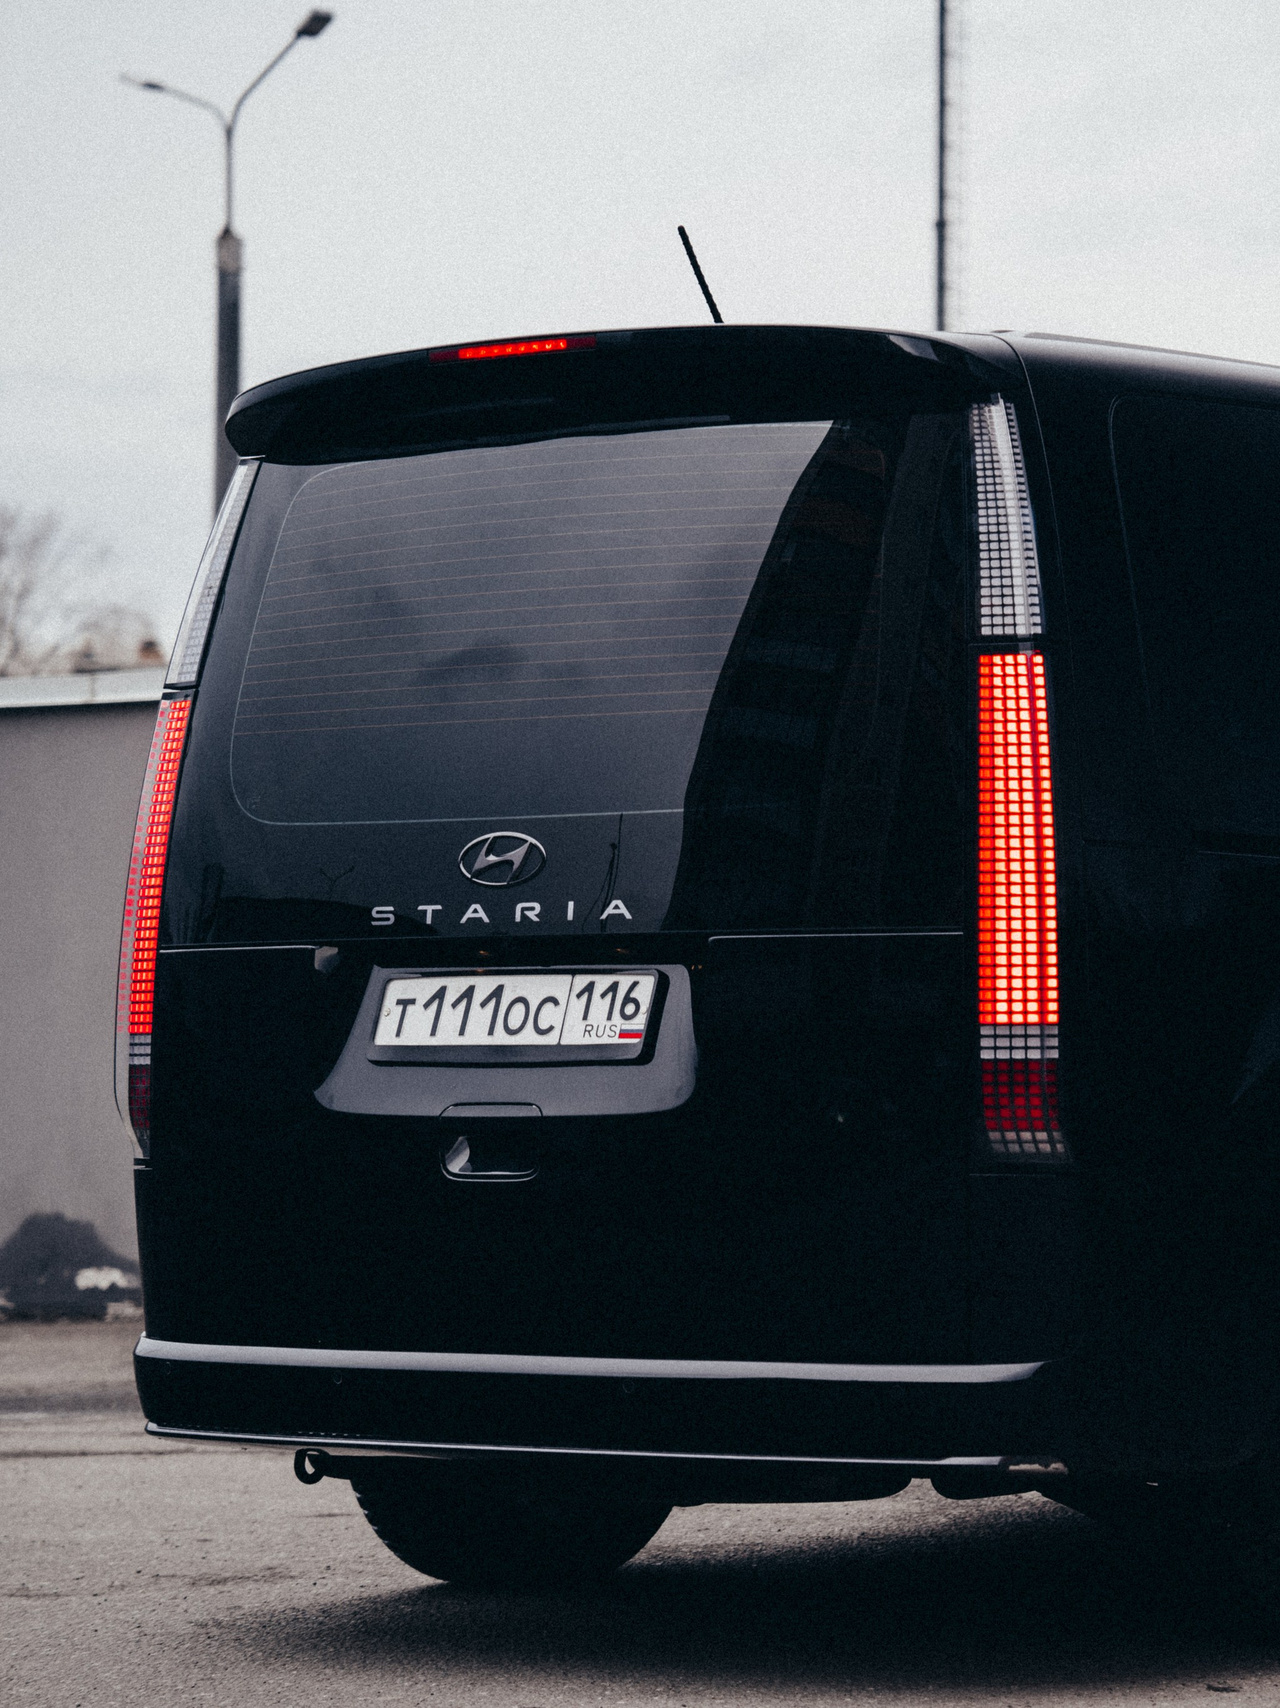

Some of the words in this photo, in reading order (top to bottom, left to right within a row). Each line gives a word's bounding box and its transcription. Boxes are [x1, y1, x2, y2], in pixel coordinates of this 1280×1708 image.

[371, 900, 632, 925] STARIA
[575, 981, 641, 1021] 116
[583, 1024, 618, 1038] RUS
